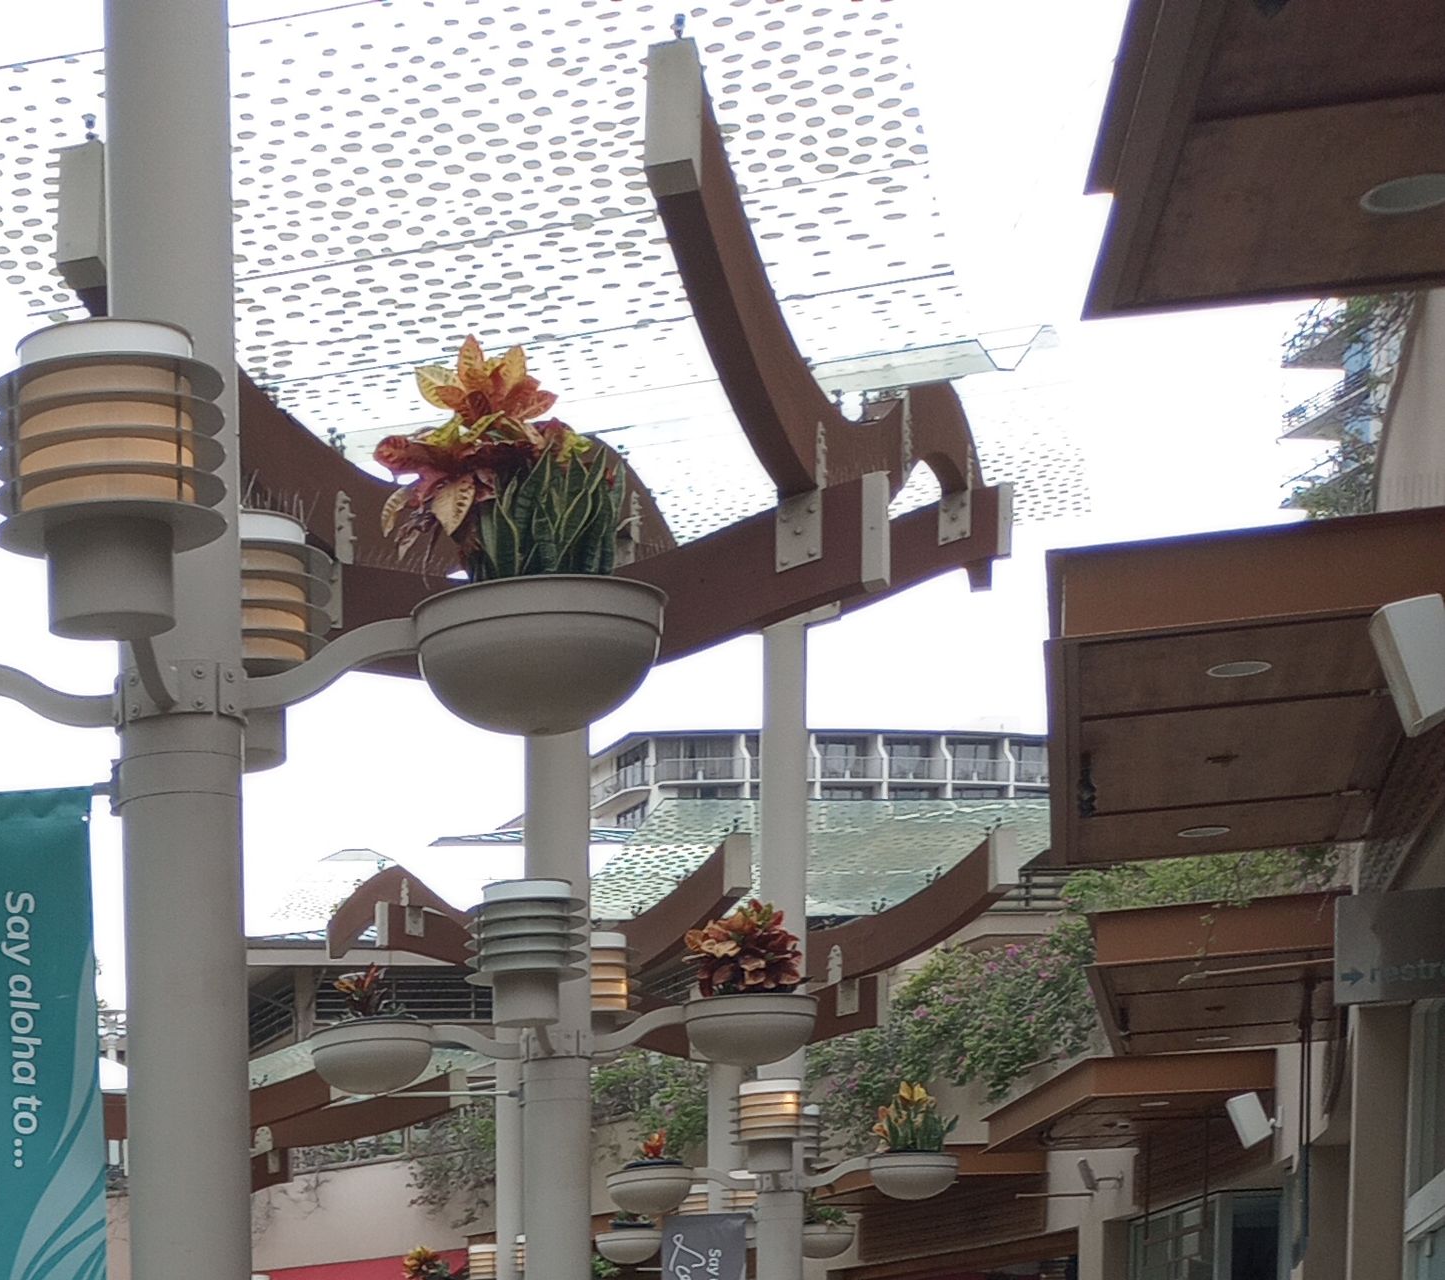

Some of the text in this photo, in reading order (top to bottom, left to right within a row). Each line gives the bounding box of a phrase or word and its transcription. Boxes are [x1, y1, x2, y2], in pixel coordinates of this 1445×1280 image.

[1, 890, 43, 1168] Say aloha to...
[706, 1248, 722, 1276] Say
